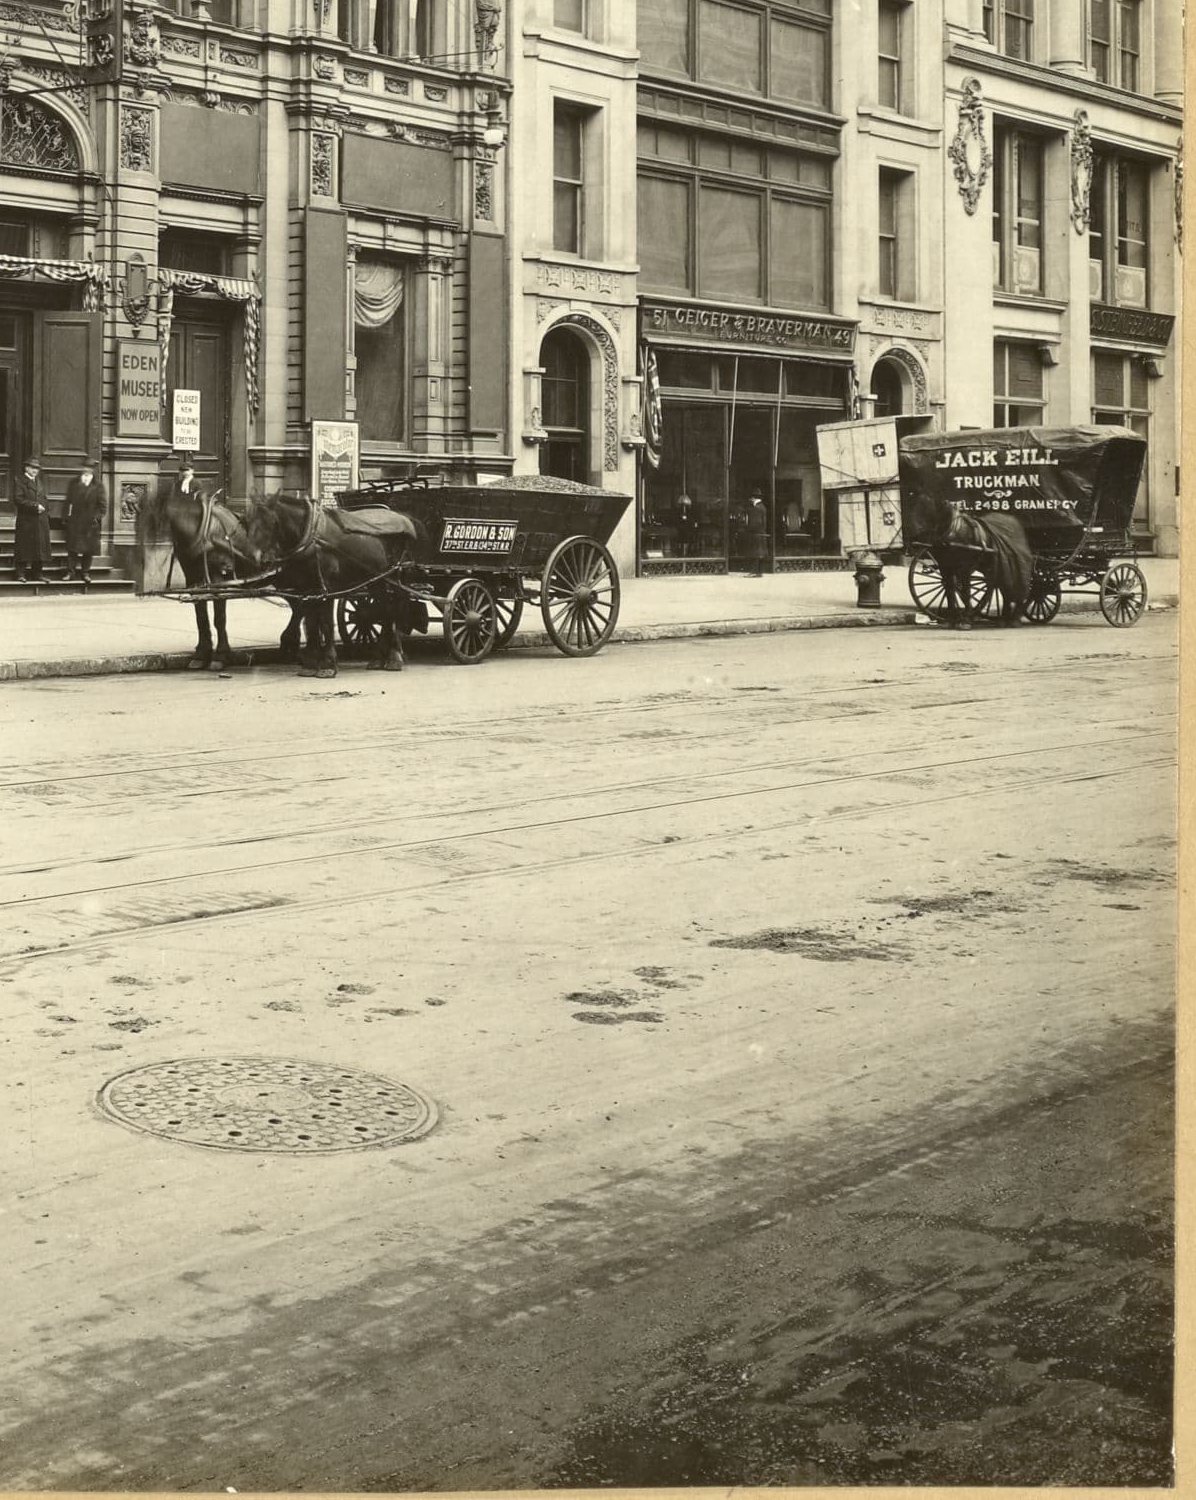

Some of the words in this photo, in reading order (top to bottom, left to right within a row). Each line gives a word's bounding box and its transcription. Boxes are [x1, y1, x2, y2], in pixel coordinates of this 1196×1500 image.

[653, 309, 670, 327] 51
[674, 307, 730, 329] GEIGER
[733, 315, 745, 330] &
[747, 316, 832, 339] BRAVERMAN
[833, 329, 852, 345] 49
[122, 354, 158, 372] EDEN
[121, 380, 159, 398] MUSEE
[120, 408, 138, 421] NOW
[139, 409, 159, 423] OPEN
[935, 450, 998, 469] JACK
[953, 474, 1041, 489] TRUCKMAN
[453, 525, 489, 540] GORDON
[489, 526, 496, 540] &
[497, 527, 516, 541] SON
